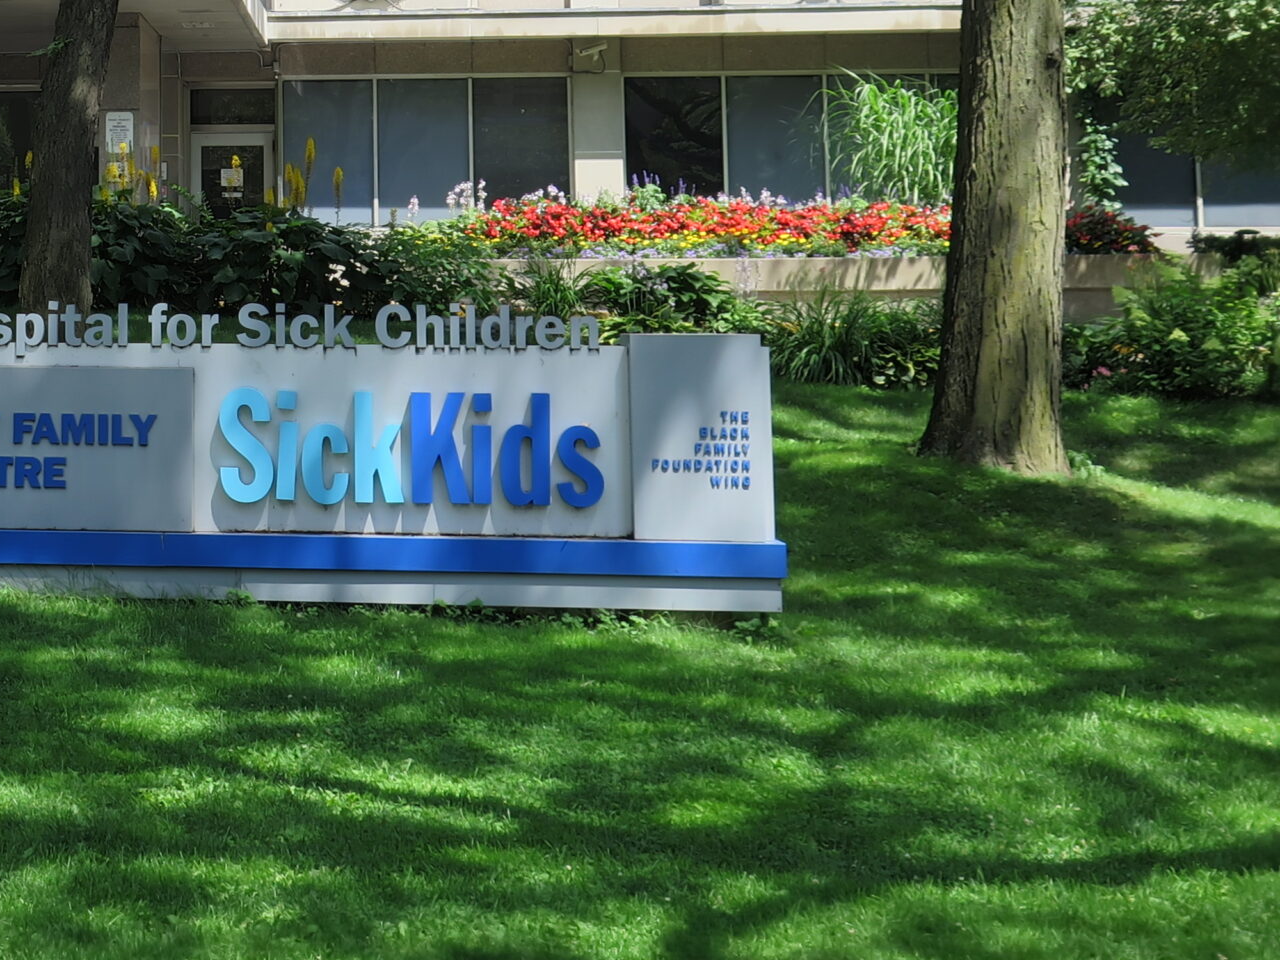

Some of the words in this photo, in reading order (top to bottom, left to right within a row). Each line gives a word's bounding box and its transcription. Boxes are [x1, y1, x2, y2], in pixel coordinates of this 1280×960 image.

[148, 302, 219, 348] for
[236, 303, 355, 349] Sick
[375, 304, 600, 351] Children
[720, 411, 750, 425] THE
[12, 412, 158, 447] FAMILY
[699, 427, 750, 441] BLACK
[218, 386, 605, 508] SickKids
[693, 442, 751, 457] FAMILY
[651, 458, 751, 474] FOUNDATION
[709, 475, 751, 490] WING
